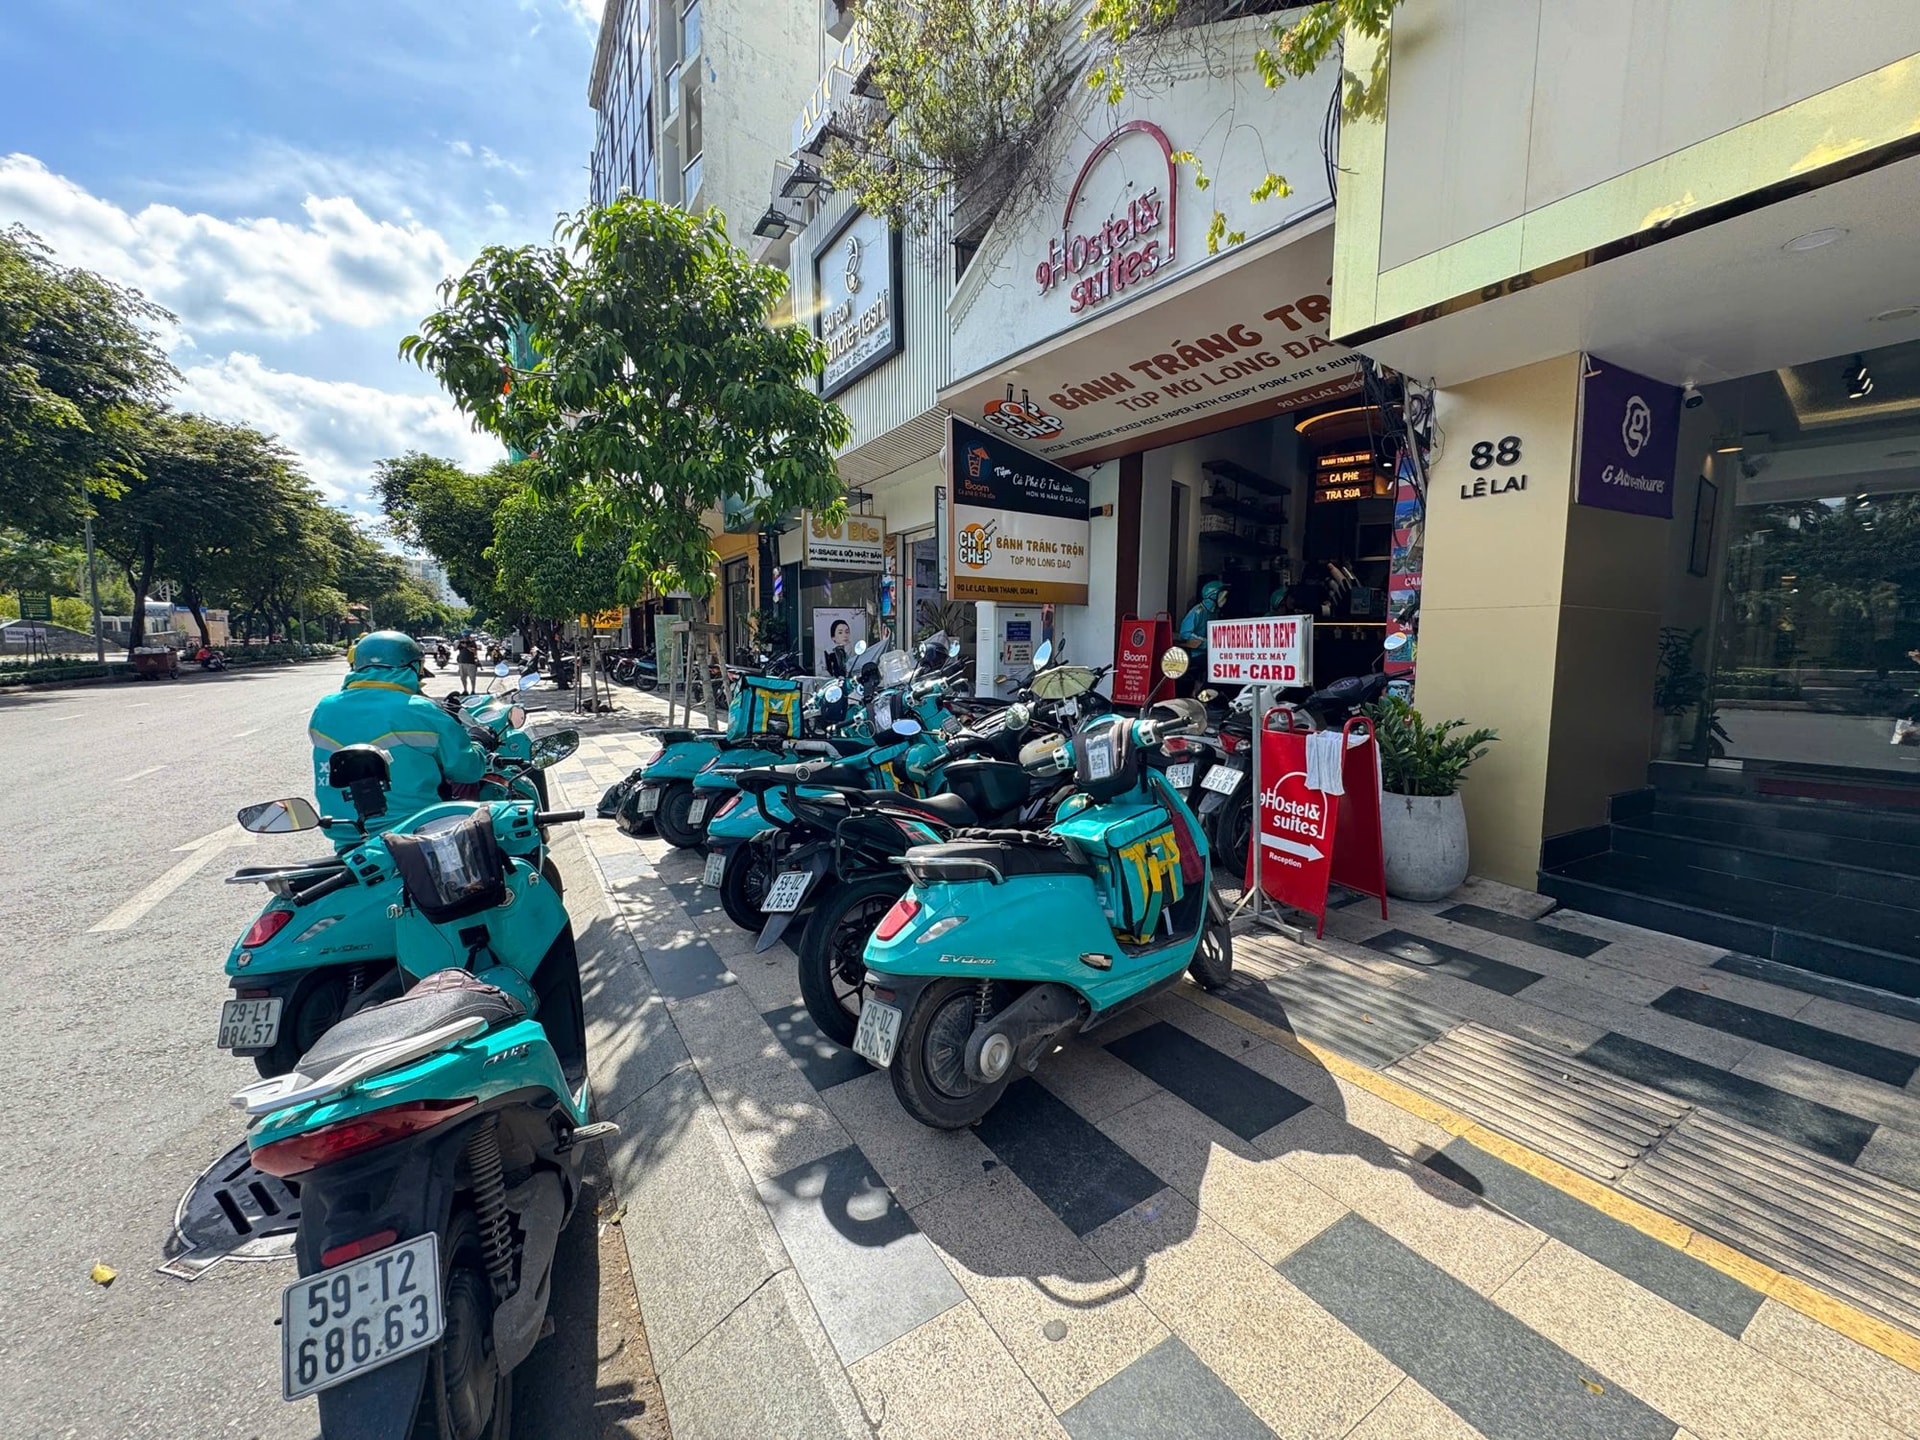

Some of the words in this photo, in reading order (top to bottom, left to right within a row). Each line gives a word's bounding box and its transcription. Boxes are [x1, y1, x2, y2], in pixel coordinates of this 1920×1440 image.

[1070, 241, 1160, 313] suites
[1048, 383, 1136, 411] BÁNH
[1129, 323, 1263, 381] TRÁNG
[1263, 280, 1332, 332] TR
[1068, 428, 1114, 449] VIETNAMESE
[1114, 421, 1141, 434] MIXED
[1140, 414, 1163, 427] RICE
[1163, 406, 1192, 421] PAPER
[1192, 398, 1220, 413] WITH
[1219, 386, 1258, 404] CRISPY
[1258, 375, 1292, 391] PORK
[1291, 368, 1314, 382] FAT
[1316, 364, 1327, 374] &
[1277, 399, 1293, 409] 90
[1470, 435, 1522, 470] 88
[1039, 478, 1047, 489] &
[1602, 465, 1614, 483] G
[964, 479, 990, 493] Boom
[1460, 477, 1487, 500] LÊ
[1490, 474, 1528, 495] LAI
[847, 521, 880, 543] Bis
[996, 535, 1023, 551] BÁNH
[1026, 538, 1058, 554] TRÁNG
[1060, 541, 1085, 558] TRỘN
[956, 584, 965, 592] 90
[1212, 624, 1254, 649] MOTORBIKE
[1255, 623, 1271, 649] FOR
[1273, 622, 1296, 649] RENT
[1123, 650, 1147, 662] Boom
[1257, 652, 1267, 660] XE
[1273, 814, 1318, 837] suites
[1269, 851, 1302, 868] Reception
[228, 1001, 271, 1024] 29-L1
[308, 1249, 417, 1328] 59-T2
[298, 1294, 429, 1386] 686.63
